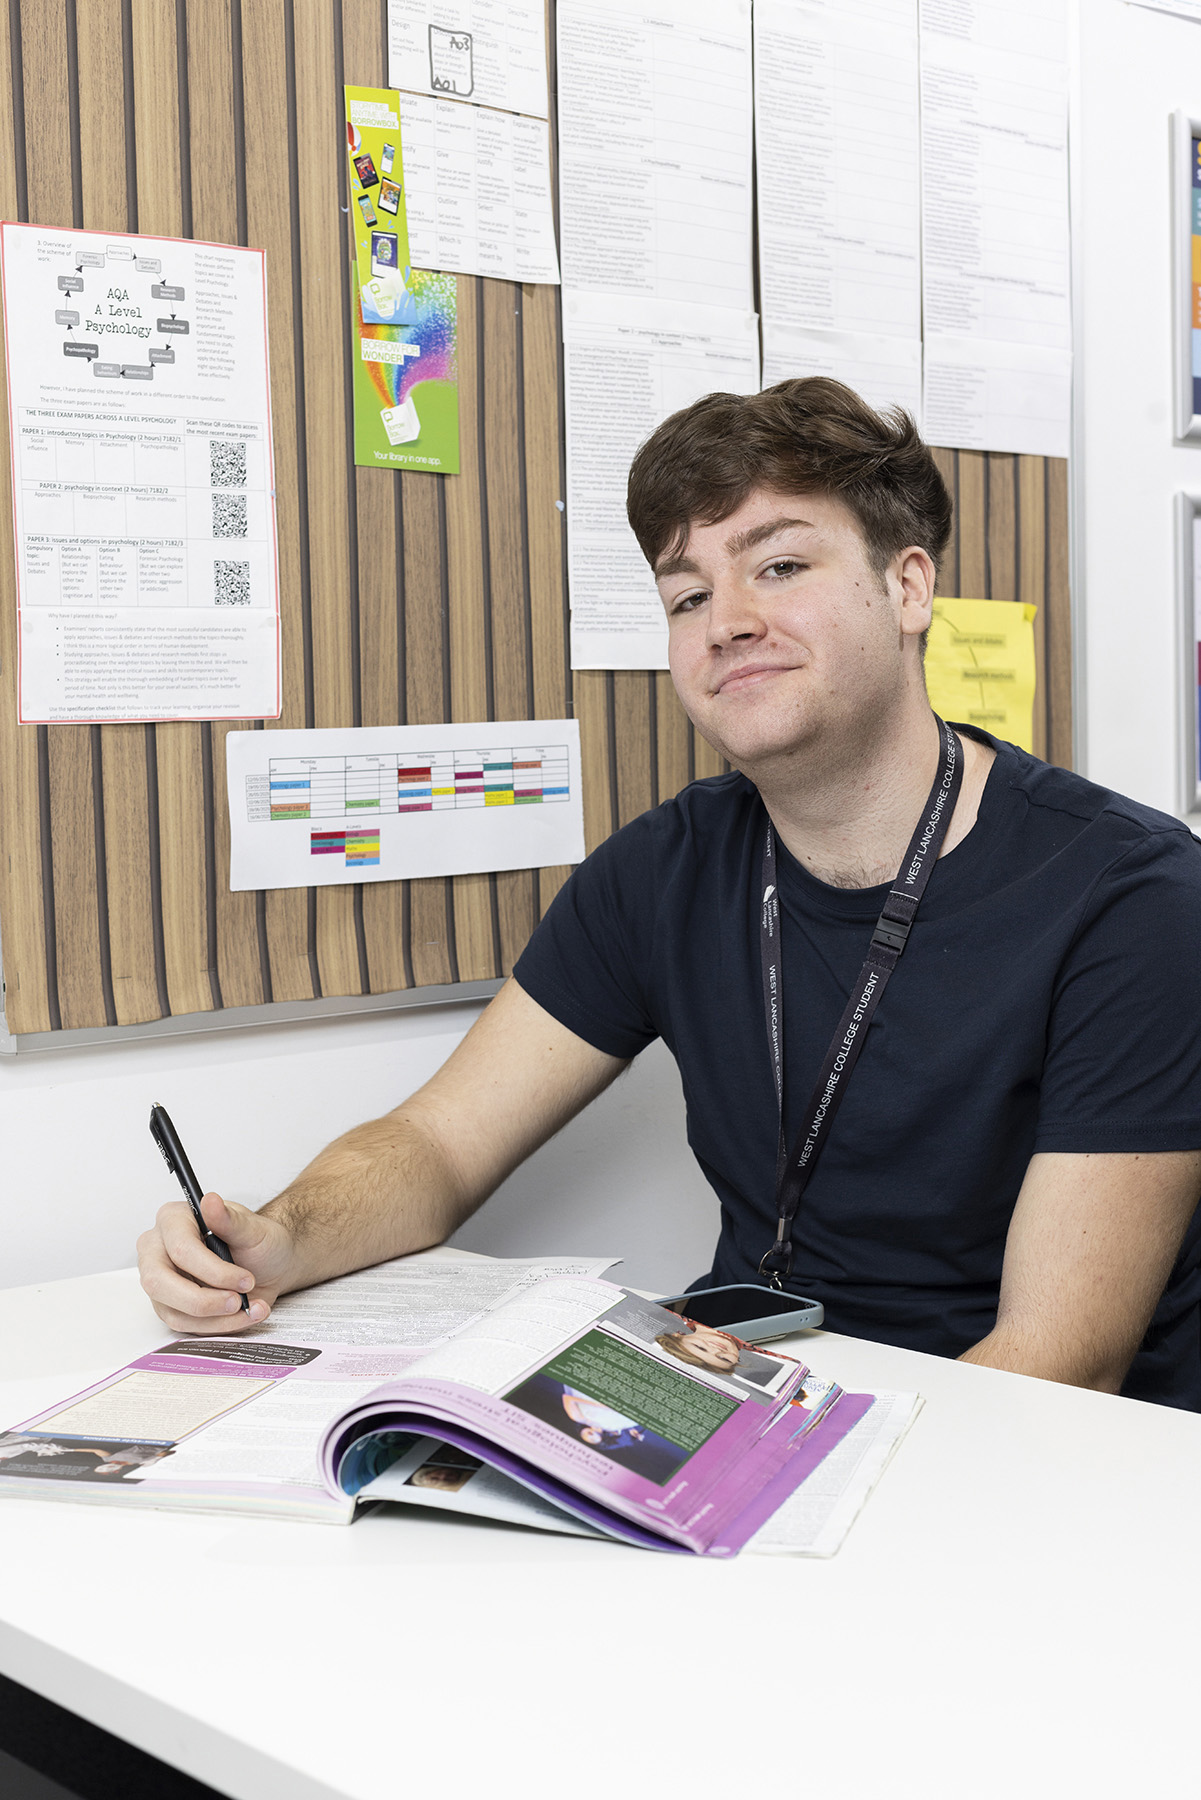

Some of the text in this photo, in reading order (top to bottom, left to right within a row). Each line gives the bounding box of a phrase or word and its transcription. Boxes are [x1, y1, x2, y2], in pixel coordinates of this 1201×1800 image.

[107, 288, 129, 302] AQA
[94, 304, 143, 318] A Level
[85, 320, 151, 339] Psychology
[362, 339, 419, 355] BORROW FOR
[363, 350, 402, 363] WONDER
[26, 409, 36, 417] THE
[38, 410, 55, 418] THREE
[57, 411, 73, 419] EXAM
[74, 412, 94, 420] PAPERS
[95, 413, 117, 421] ACROSS
[124, 415, 140, 423] LEVEL
[141, 416, 176, 424] PSYCHOLOGY
[199, 419, 212, 427] these
[222, 421, 235, 429] codes
[46, 429, 81, 439] introductory
[82, 431, 97, 439] topics
[105, 432, 136, 442] Psychology
[144, 434, 161, 442] hours)
[162, 435, 181, 443] 7182/1
[373, 450, 388, 460] Your
[389, 451, 408, 463] library
[415, 455, 427, 463] one
[428, 457, 442, 466] app.
[40, 482, 56, 490] PAPER
[64, 484, 94, 492] psychology
[131, 486, 148, 494] hours)
[904, 856, 924, 886] WEST
[917, 788, 949, 855] LANCASHIRE
[942, 745, 956, 789] COLLEGE
[769, 964, 777, 995] WEST
[771, 997, 780, 1063] LANCASHIRE
[797, 971, 880, 1169] WEST LANCASHIRE COLLEGE STUDENT
